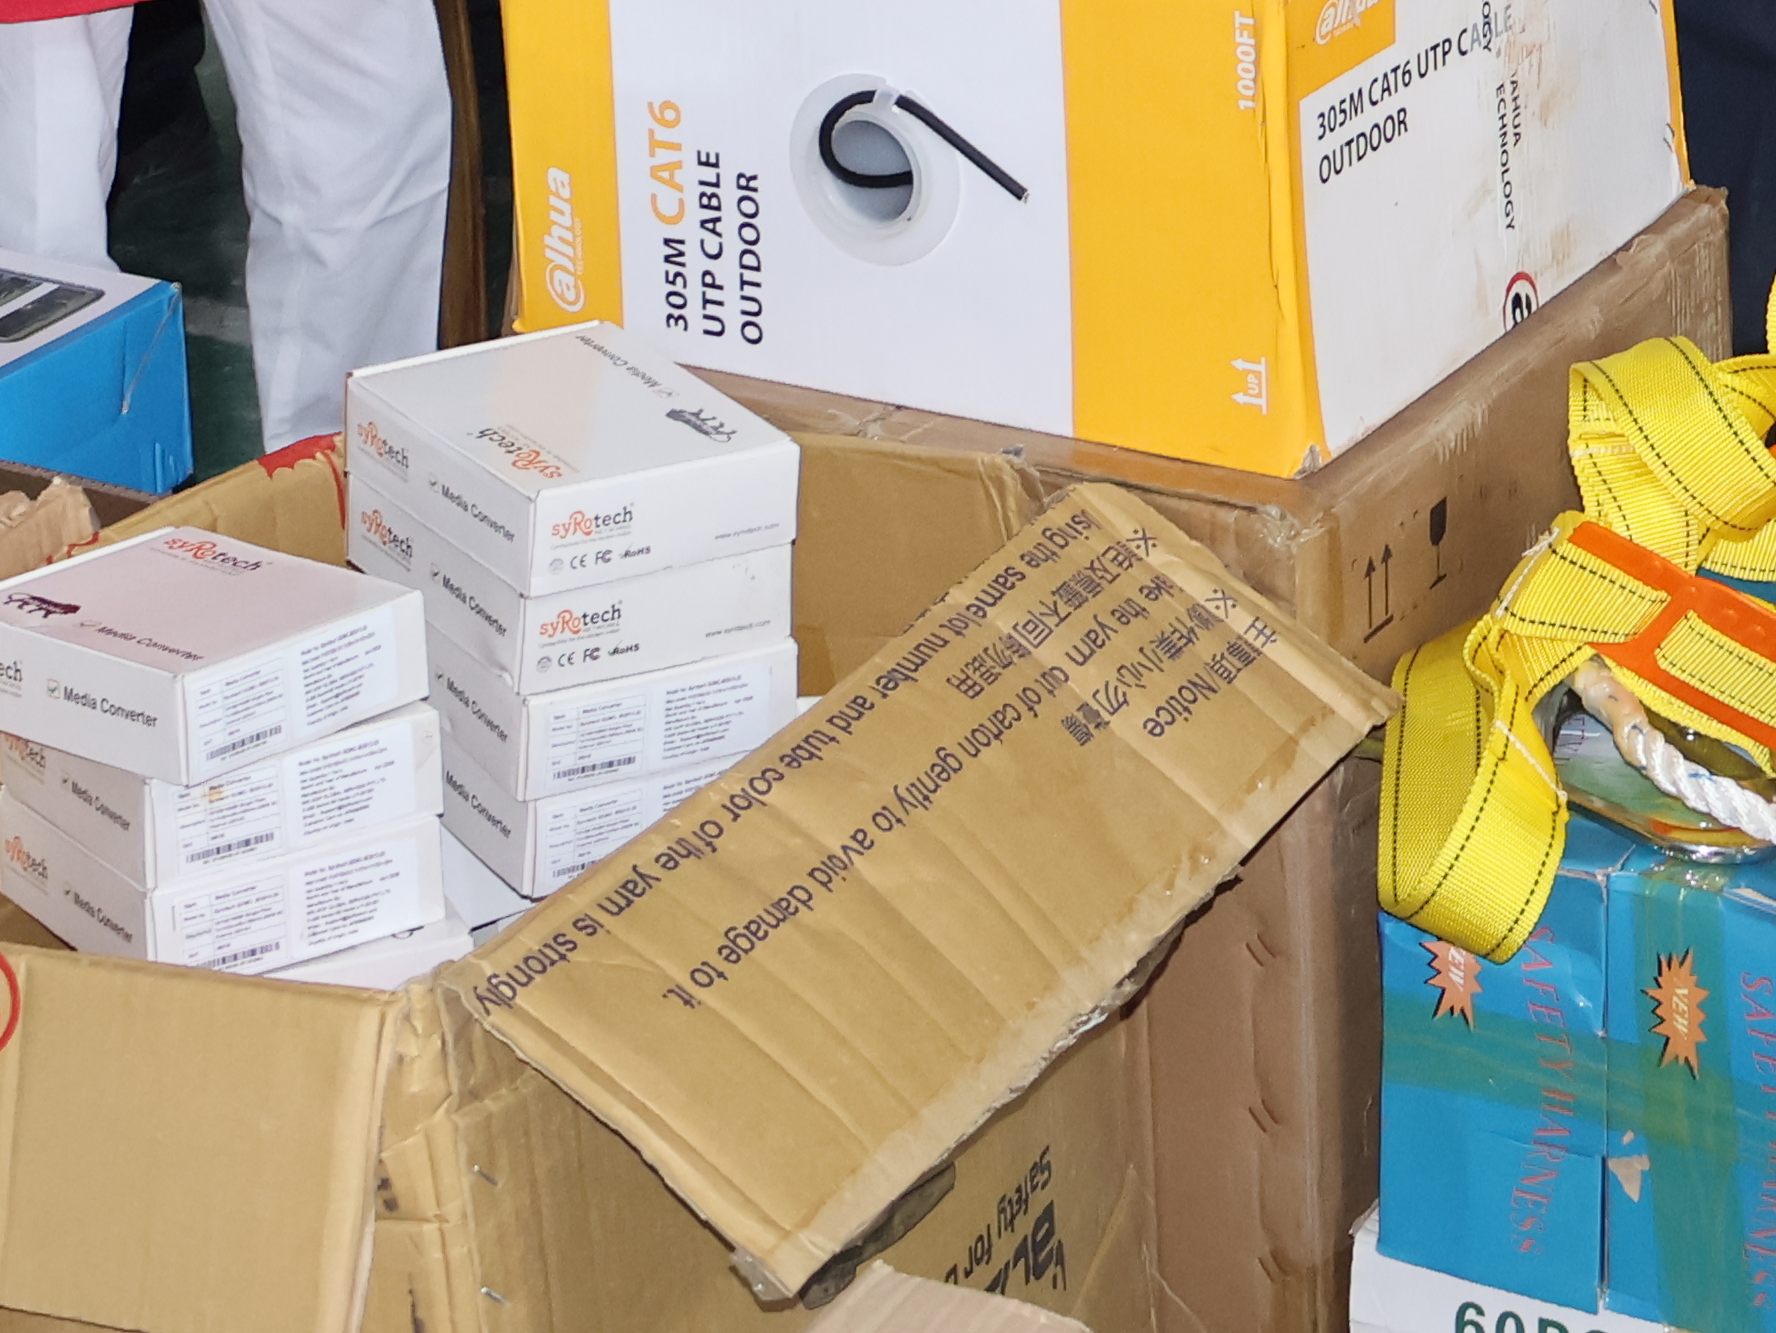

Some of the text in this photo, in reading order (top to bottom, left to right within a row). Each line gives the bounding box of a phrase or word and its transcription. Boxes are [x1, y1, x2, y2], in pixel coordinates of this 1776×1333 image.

[1235, 10, 1257, 112] 1000FT
[1317, 89, 1365, 141] 305M
[1368, 61, 1413, 113] CAT6
[1417, 42, 1452, 88] UTP
[1318, 106, 1409, 185] OUTDOOR
[1495, 83, 1517, 231] ECHNOLOGY
[648, 99, 689, 332] 305M CAT6
[698, 150, 725, 337] UTP CABLE
[735, 172, 764, 346] OUTDOOR
[1247, 368, 1261, 395] UP
[441, 483, 470, 512] Media
[552, 506, 634, 539] syRotech
[570, 554, 587, 570] CE
[1020, 543, 1057, 567] the
[442, 574, 468, 603] Media
[966, 567, 1026, 626] same
[1111, 598, 1149, 625] the
[539, 602, 622, 638] syRotech
[1065, 614, 1118, 666] yarn
[557, 650, 575, 666] CE
[871, 633, 949, 699] number
[63, 686, 158, 729] Media Converter
[446, 676, 472, 706] Media
[1016, 687, 1041, 718] of
[826, 696, 874, 735] and
[958, 704, 1021, 757] carton
[779, 730, 839, 768] tube
[445, 769, 469, 799] Media
[721, 768, 785, 822] color
[894, 747, 963, 815] gently
[692, 821, 723, 853] of
[872, 806, 906, 832] to
[807, 829, 874, 892] avoid
[597, 865, 661, 916] yarn
[572, 914, 604, 936] is
[718, 885, 813, 964] damage
[473, 933, 577, 1016] strongly
[662, 985, 695, 1008] it.
[690, 961, 728, 987] to
[1672, 985, 1692, 1042] NEW
[1511, 925, 1575, 1255] SAFETY HARNESS
[968, 1145, 1054, 1280] Safety for
